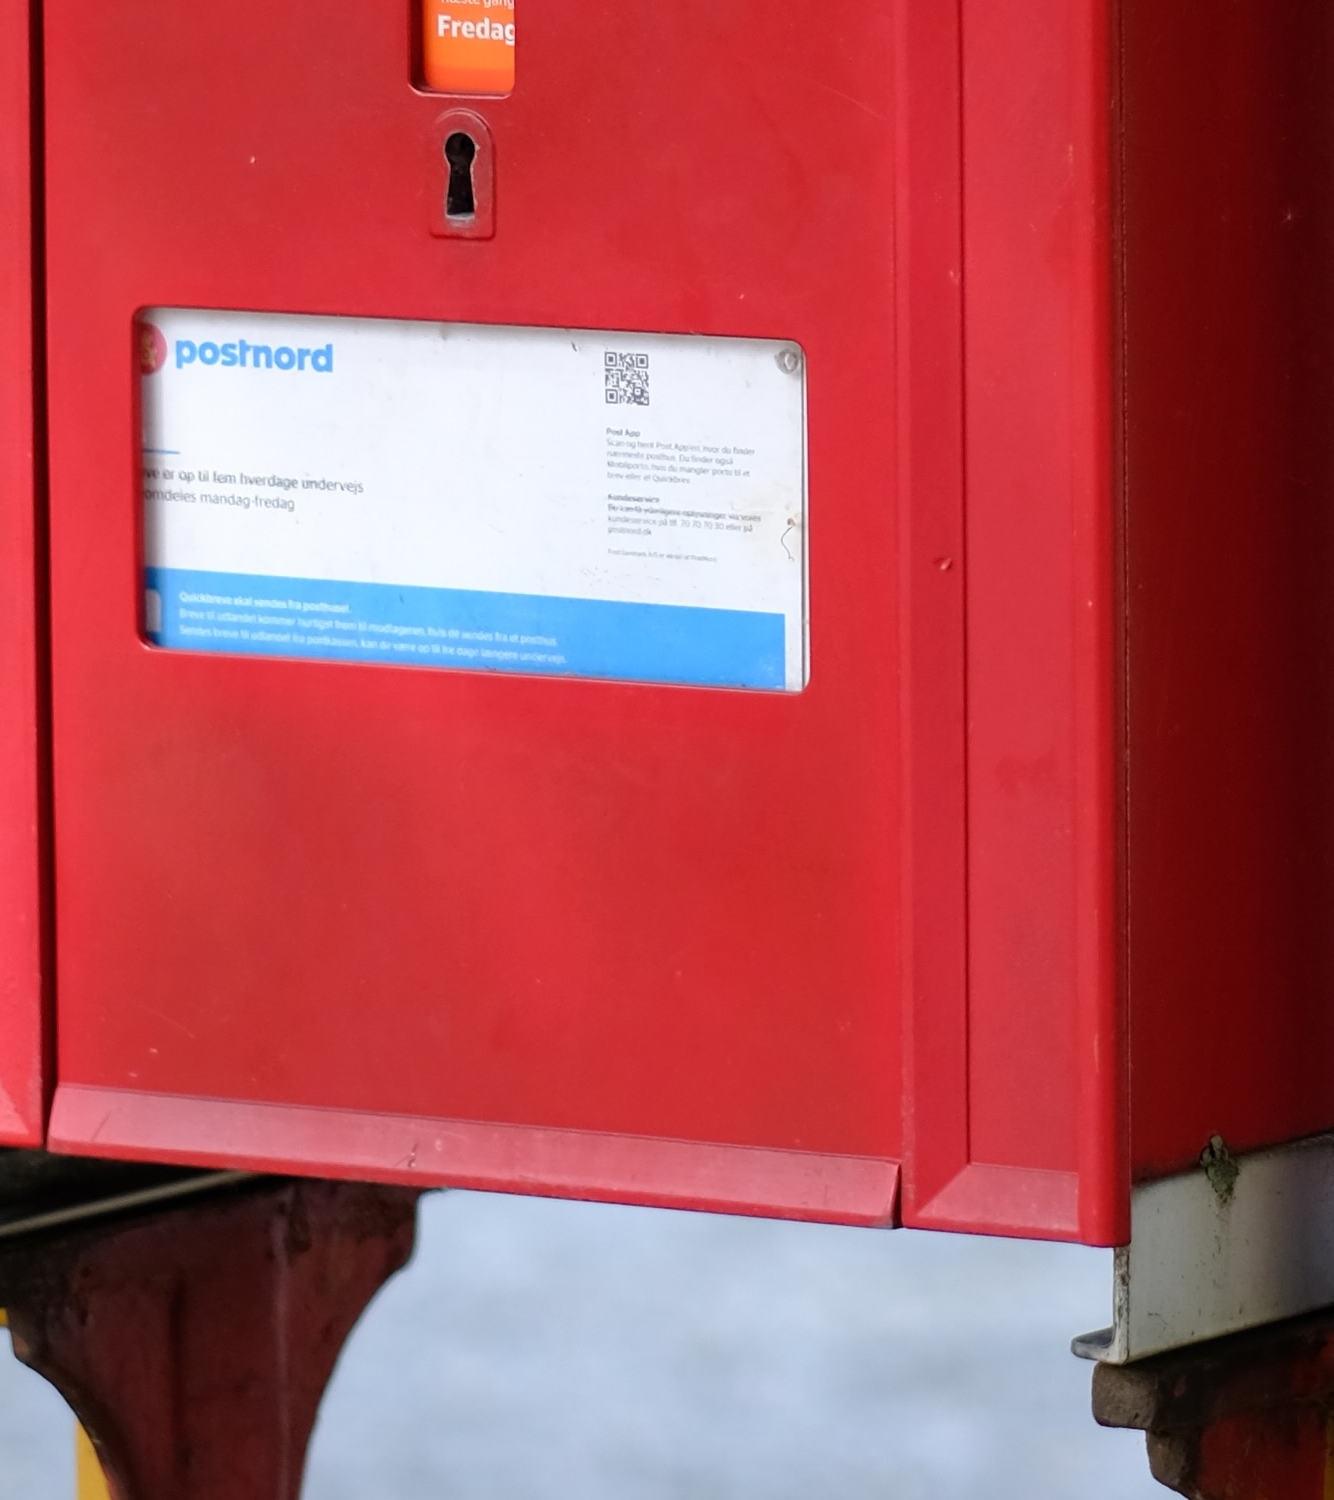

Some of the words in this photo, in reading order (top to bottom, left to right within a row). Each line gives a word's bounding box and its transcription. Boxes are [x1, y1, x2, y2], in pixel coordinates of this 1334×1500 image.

[437, 13, 515, 46] Fredag
[176, 339, 333, 372] postnord
[606, 427, 622, 435] Post
[178, 470, 195, 484] op
[213, 470, 237, 484] fem
[240, 472, 299, 490] hverdage
[302, 475, 364, 494] undervejs
